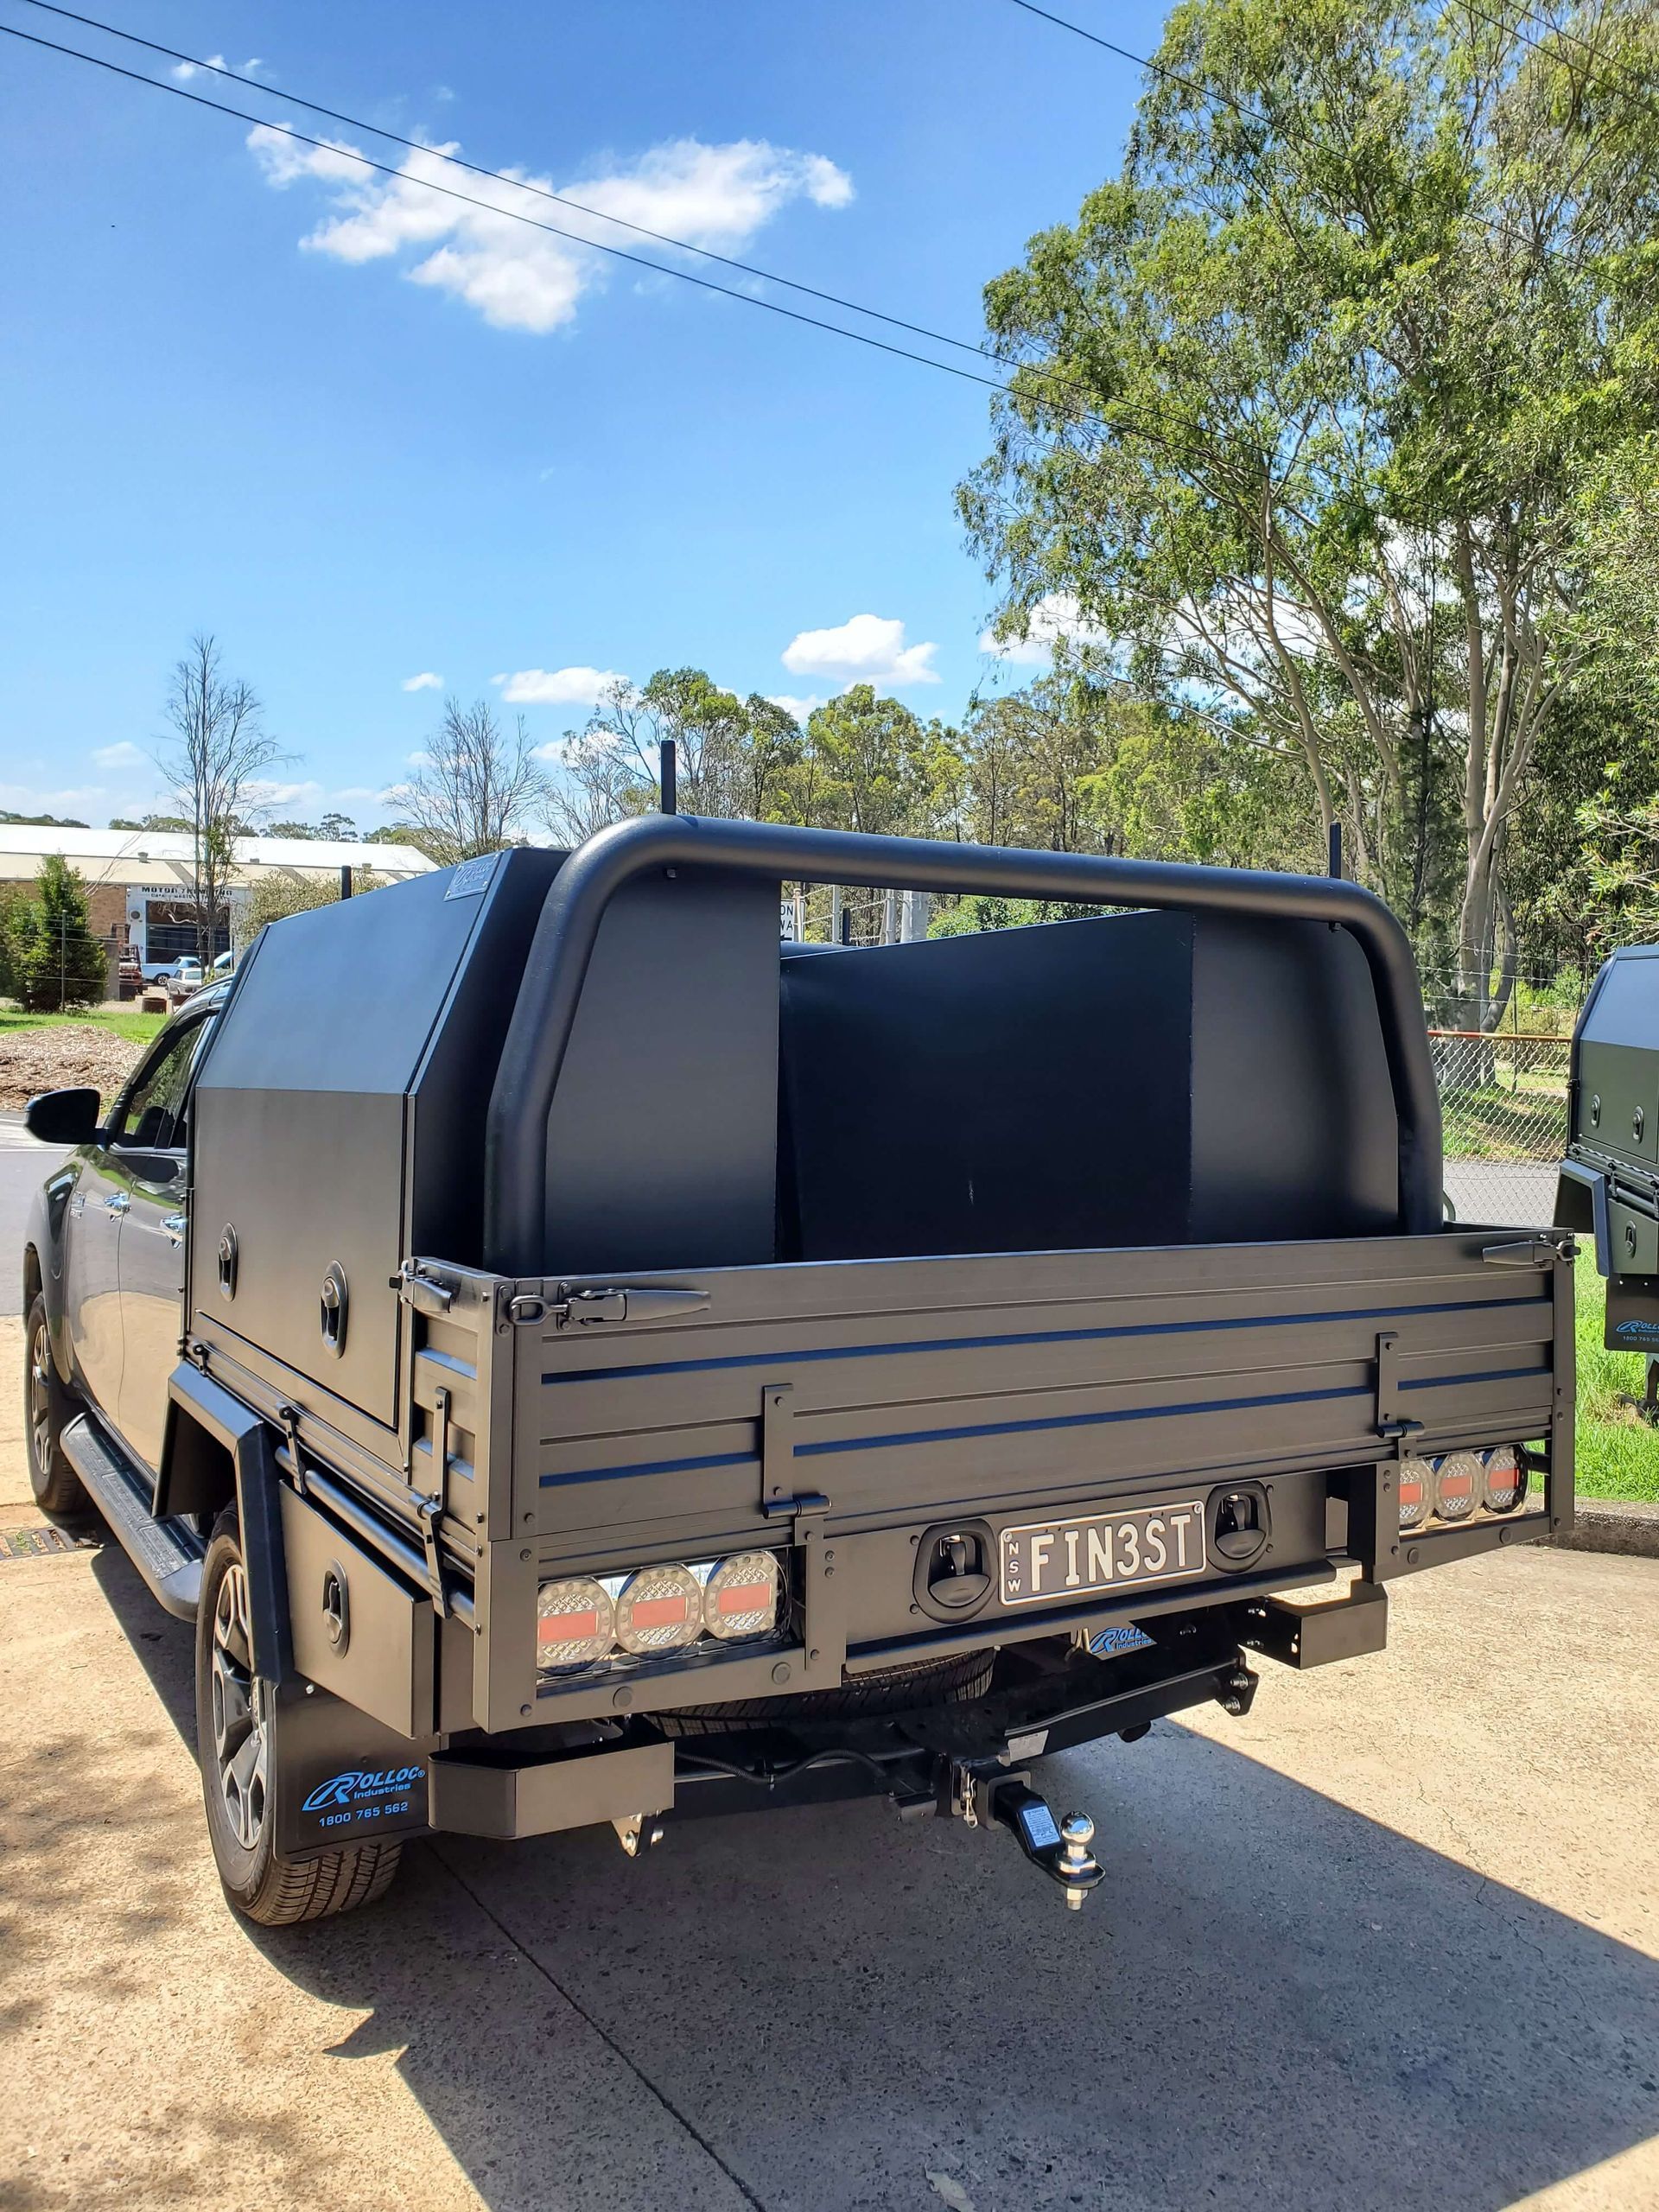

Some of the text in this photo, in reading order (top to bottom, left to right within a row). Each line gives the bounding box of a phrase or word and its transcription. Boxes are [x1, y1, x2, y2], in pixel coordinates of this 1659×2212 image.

[1031, 1514, 1191, 1592] FIN3ST
[1116, 1637, 1153, 1649] Industries
[353, 1783, 411, 1799] Industries
[319, 1801, 409, 1827] 1800 765 562
